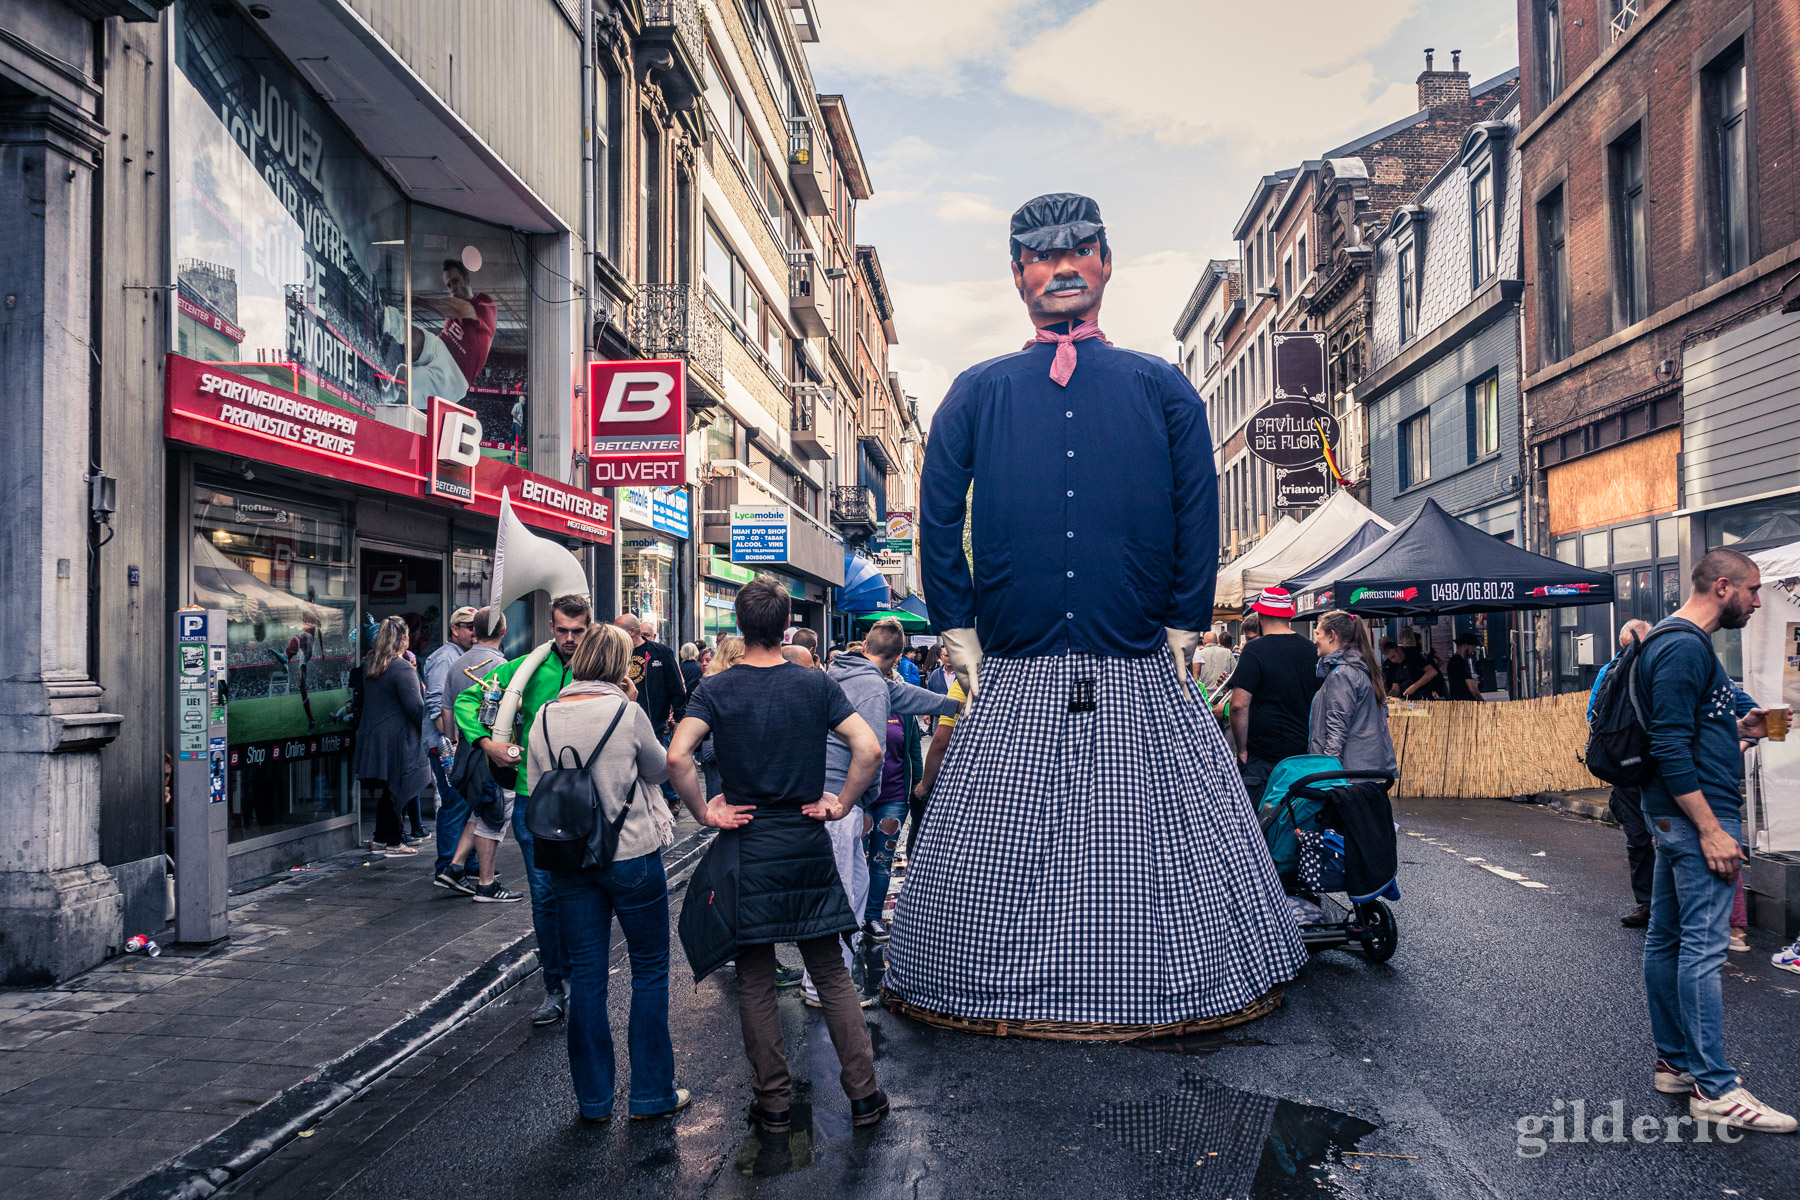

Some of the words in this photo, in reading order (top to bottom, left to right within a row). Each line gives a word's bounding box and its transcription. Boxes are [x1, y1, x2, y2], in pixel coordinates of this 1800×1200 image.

[252, 73, 323, 194] JOUEZ
[264, 164, 299, 233] SUR
[302, 197, 349, 275] VOTRE
[251, 213, 327, 321] EQUIPE
[178, 297, 209, 322] ETCENTER
[283, 309, 358, 390] FAVORITE!
[199, 372, 358, 436] SPORTWEDDENSCHAPPEN
[598, 371, 676, 423] B
[219, 403, 301, 441] PRONOSTICS
[301, 427, 356, 456] SPORTIFS
[437, 411, 484, 468] B
[593, 440, 681, 451] BETCENTER
[1255, 434, 1277, 451] DE
[595, 461, 680, 481] OUVERT
[521, 479, 609, 521] BETCENTER.BE
[1281, 484, 1324, 494] trianon
[734, 511, 785, 521] Lycamobile
[1359, 590, 1405, 600] ARROSTICINI
[1431, 581, 1515, 602] 0498/06.80.23
[184, 616, 204, 636] P
[246, 746, 265, 765] Shop
[285, 741, 305, 758] Online
